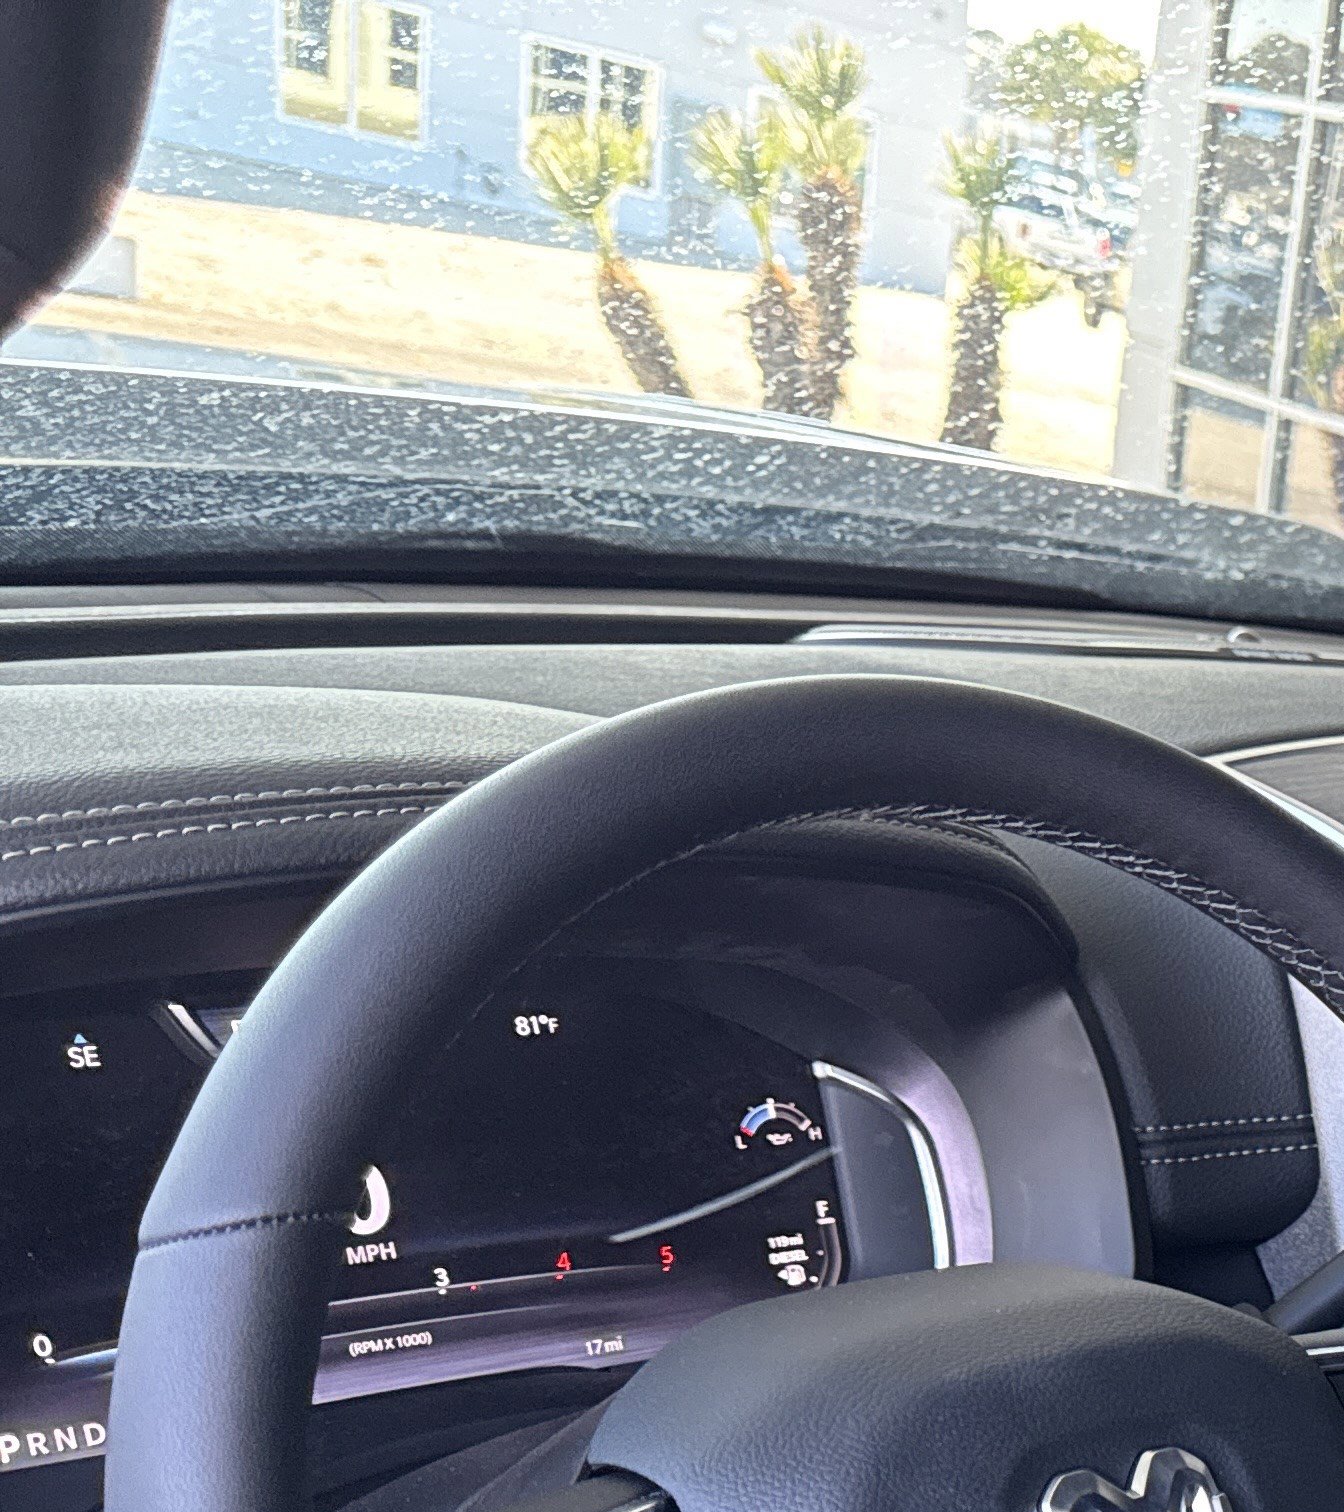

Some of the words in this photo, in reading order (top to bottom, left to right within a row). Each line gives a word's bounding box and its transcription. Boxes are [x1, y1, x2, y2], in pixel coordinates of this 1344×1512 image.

[514, 1014, 559, 1037] 81°F
[67, 1045, 101, 1068] SE
[346, 1242, 397, 1265] MPH
[555, 1252, 572, 1271] 4
[659, 1246, 674, 1265] 5
[434, 1267, 450, 1288] 3
[33, 1334, 53, 1357] 0
[348, 1337, 384, 1358] (RPM
[384, 1337, 396, 1350] X
[396, 1331, 433, 1349] 1000)
